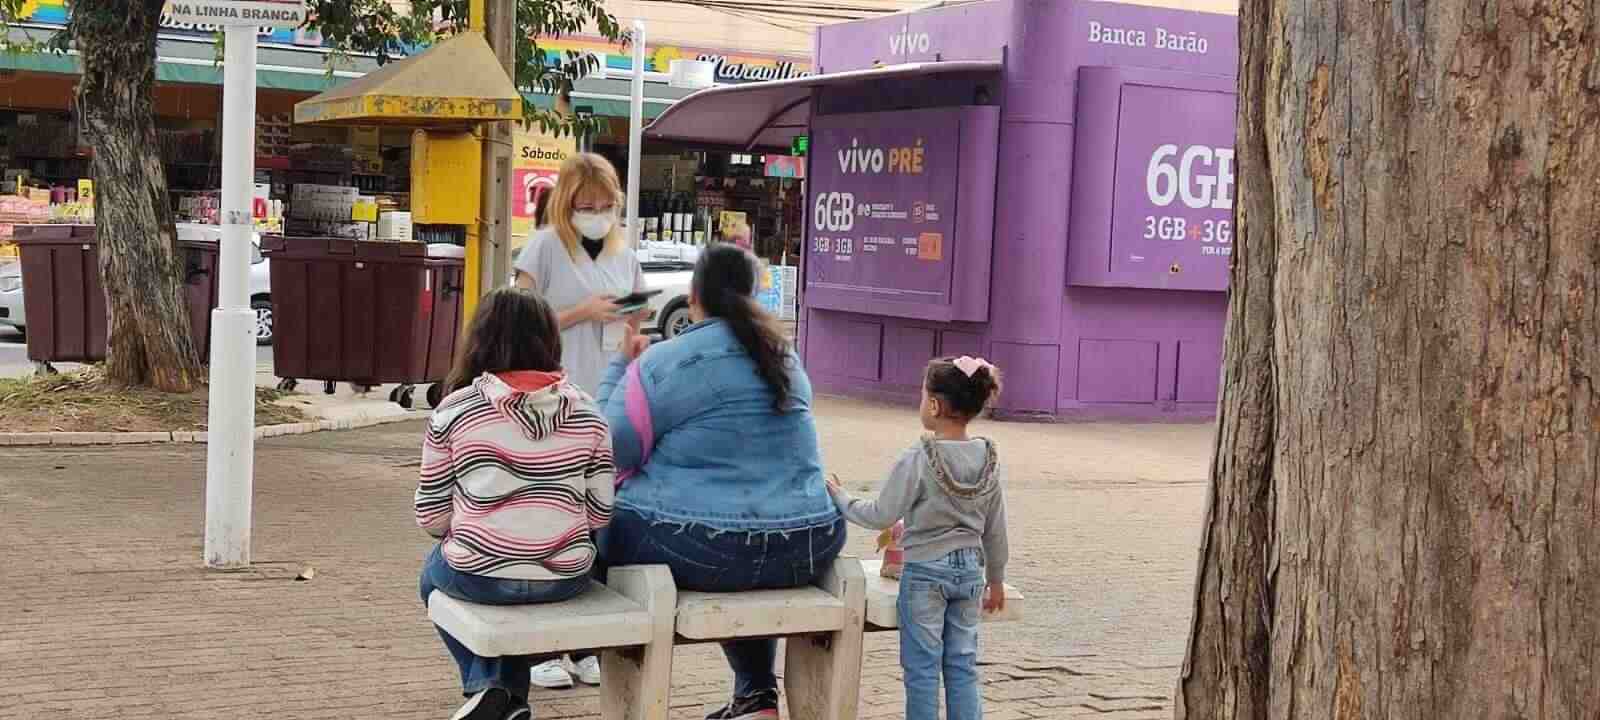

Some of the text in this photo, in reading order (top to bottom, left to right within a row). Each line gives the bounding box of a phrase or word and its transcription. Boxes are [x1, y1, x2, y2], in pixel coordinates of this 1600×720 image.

[172, 4, 299, 21] NA LINHA BRANCA
[889, 25, 929, 55] vivo
[1088, 21, 1208, 54] Banca Barão
[838, 138, 925, 174] vivo PRÉ
[814, 191, 855, 232] 6GB
[1143, 215, 1186, 241] 3GB
[1201, 219, 1233, 243] 3G
[813, 236, 830, 253] 3GB
[835, 238, 853, 254] 3GB
